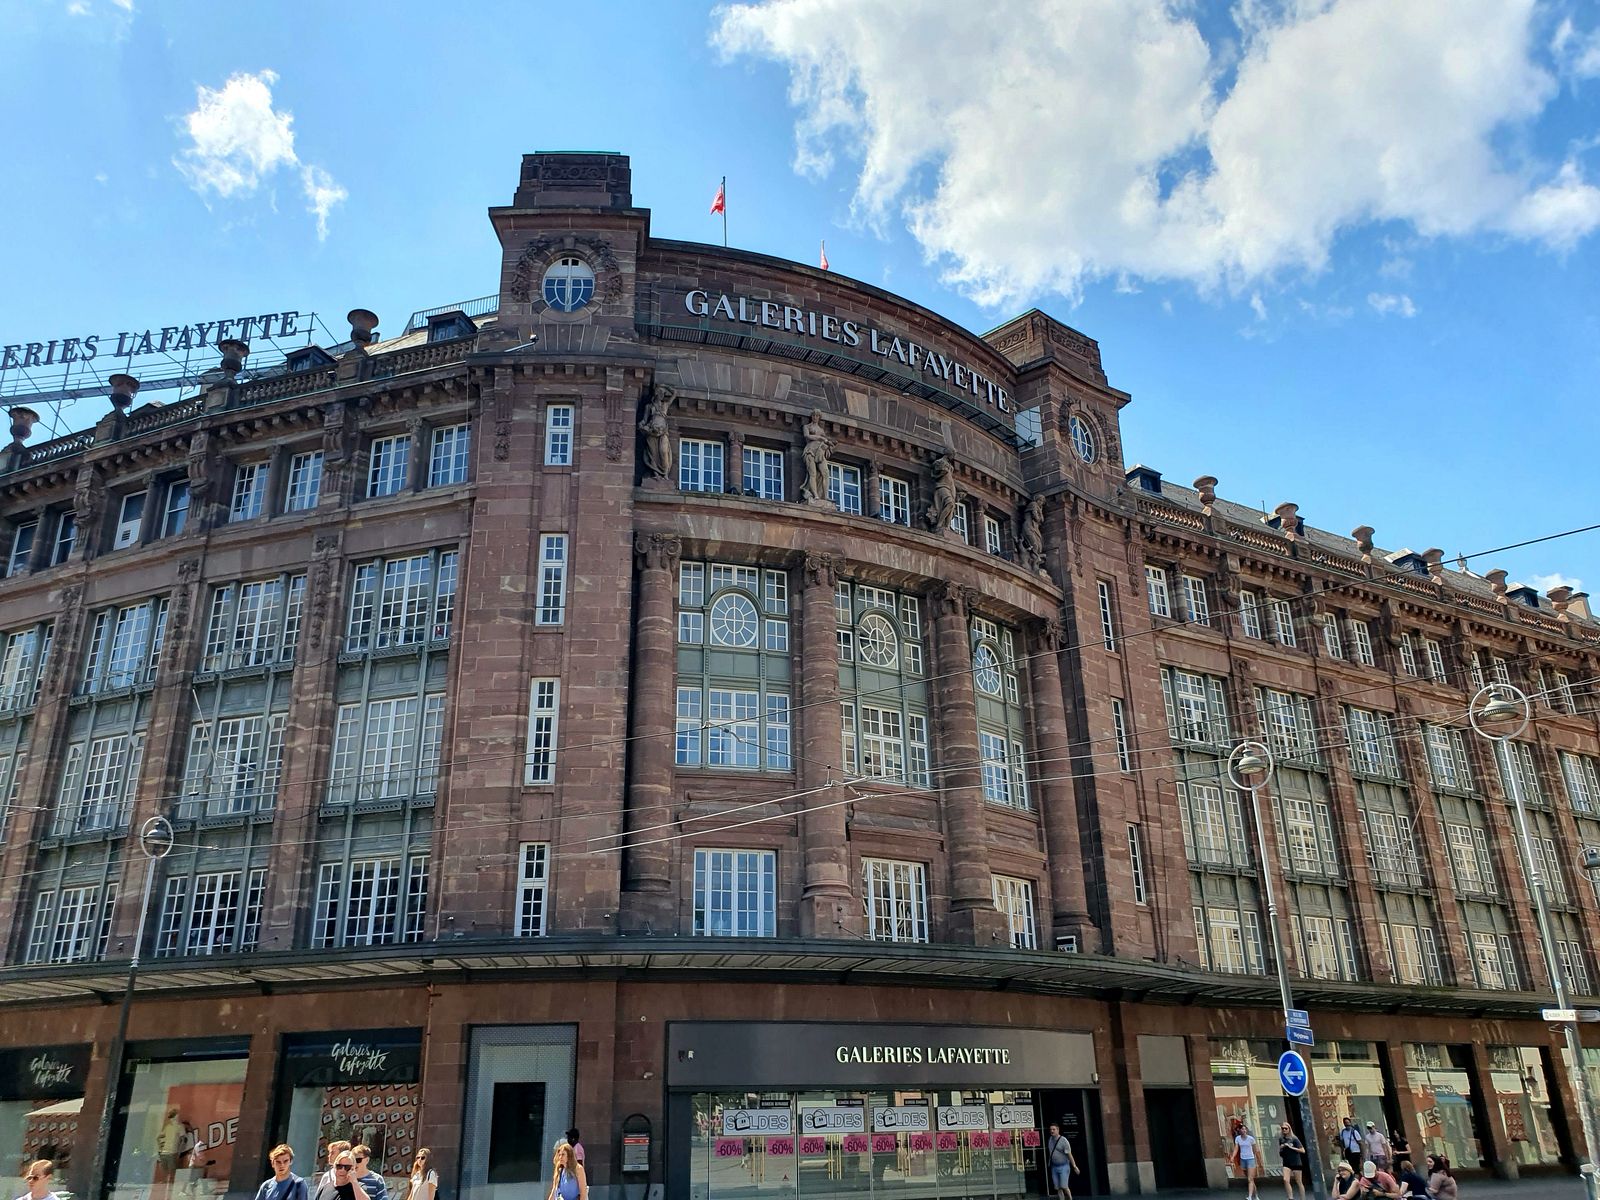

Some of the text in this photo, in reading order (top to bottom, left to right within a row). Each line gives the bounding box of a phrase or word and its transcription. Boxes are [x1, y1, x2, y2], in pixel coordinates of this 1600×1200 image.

[0, 310, 299, 370] ERIES LAFAYETTE
[685, 290, 1010, 414] GALERIES LAFAYETTE
[331, 1038, 371, 1061] Galeries
[836, 1046, 1010, 1065] GALERIES LAFAYETTE
[340, 1049, 391, 1076] Lafayette
[801, 1142, 824, 1154] -60%
[845, 1141, 868, 1152] -60%
[873, 1140, 895, 1151] -60%
[912, 1139, 933, 1150] -60%
[937, 1139, 957, 1149] -60%
[971, 1138, 990, 1147] -60%
[717, 1144, 743, 1156] -60%
[769, 1143, 794, 1155] -60%
